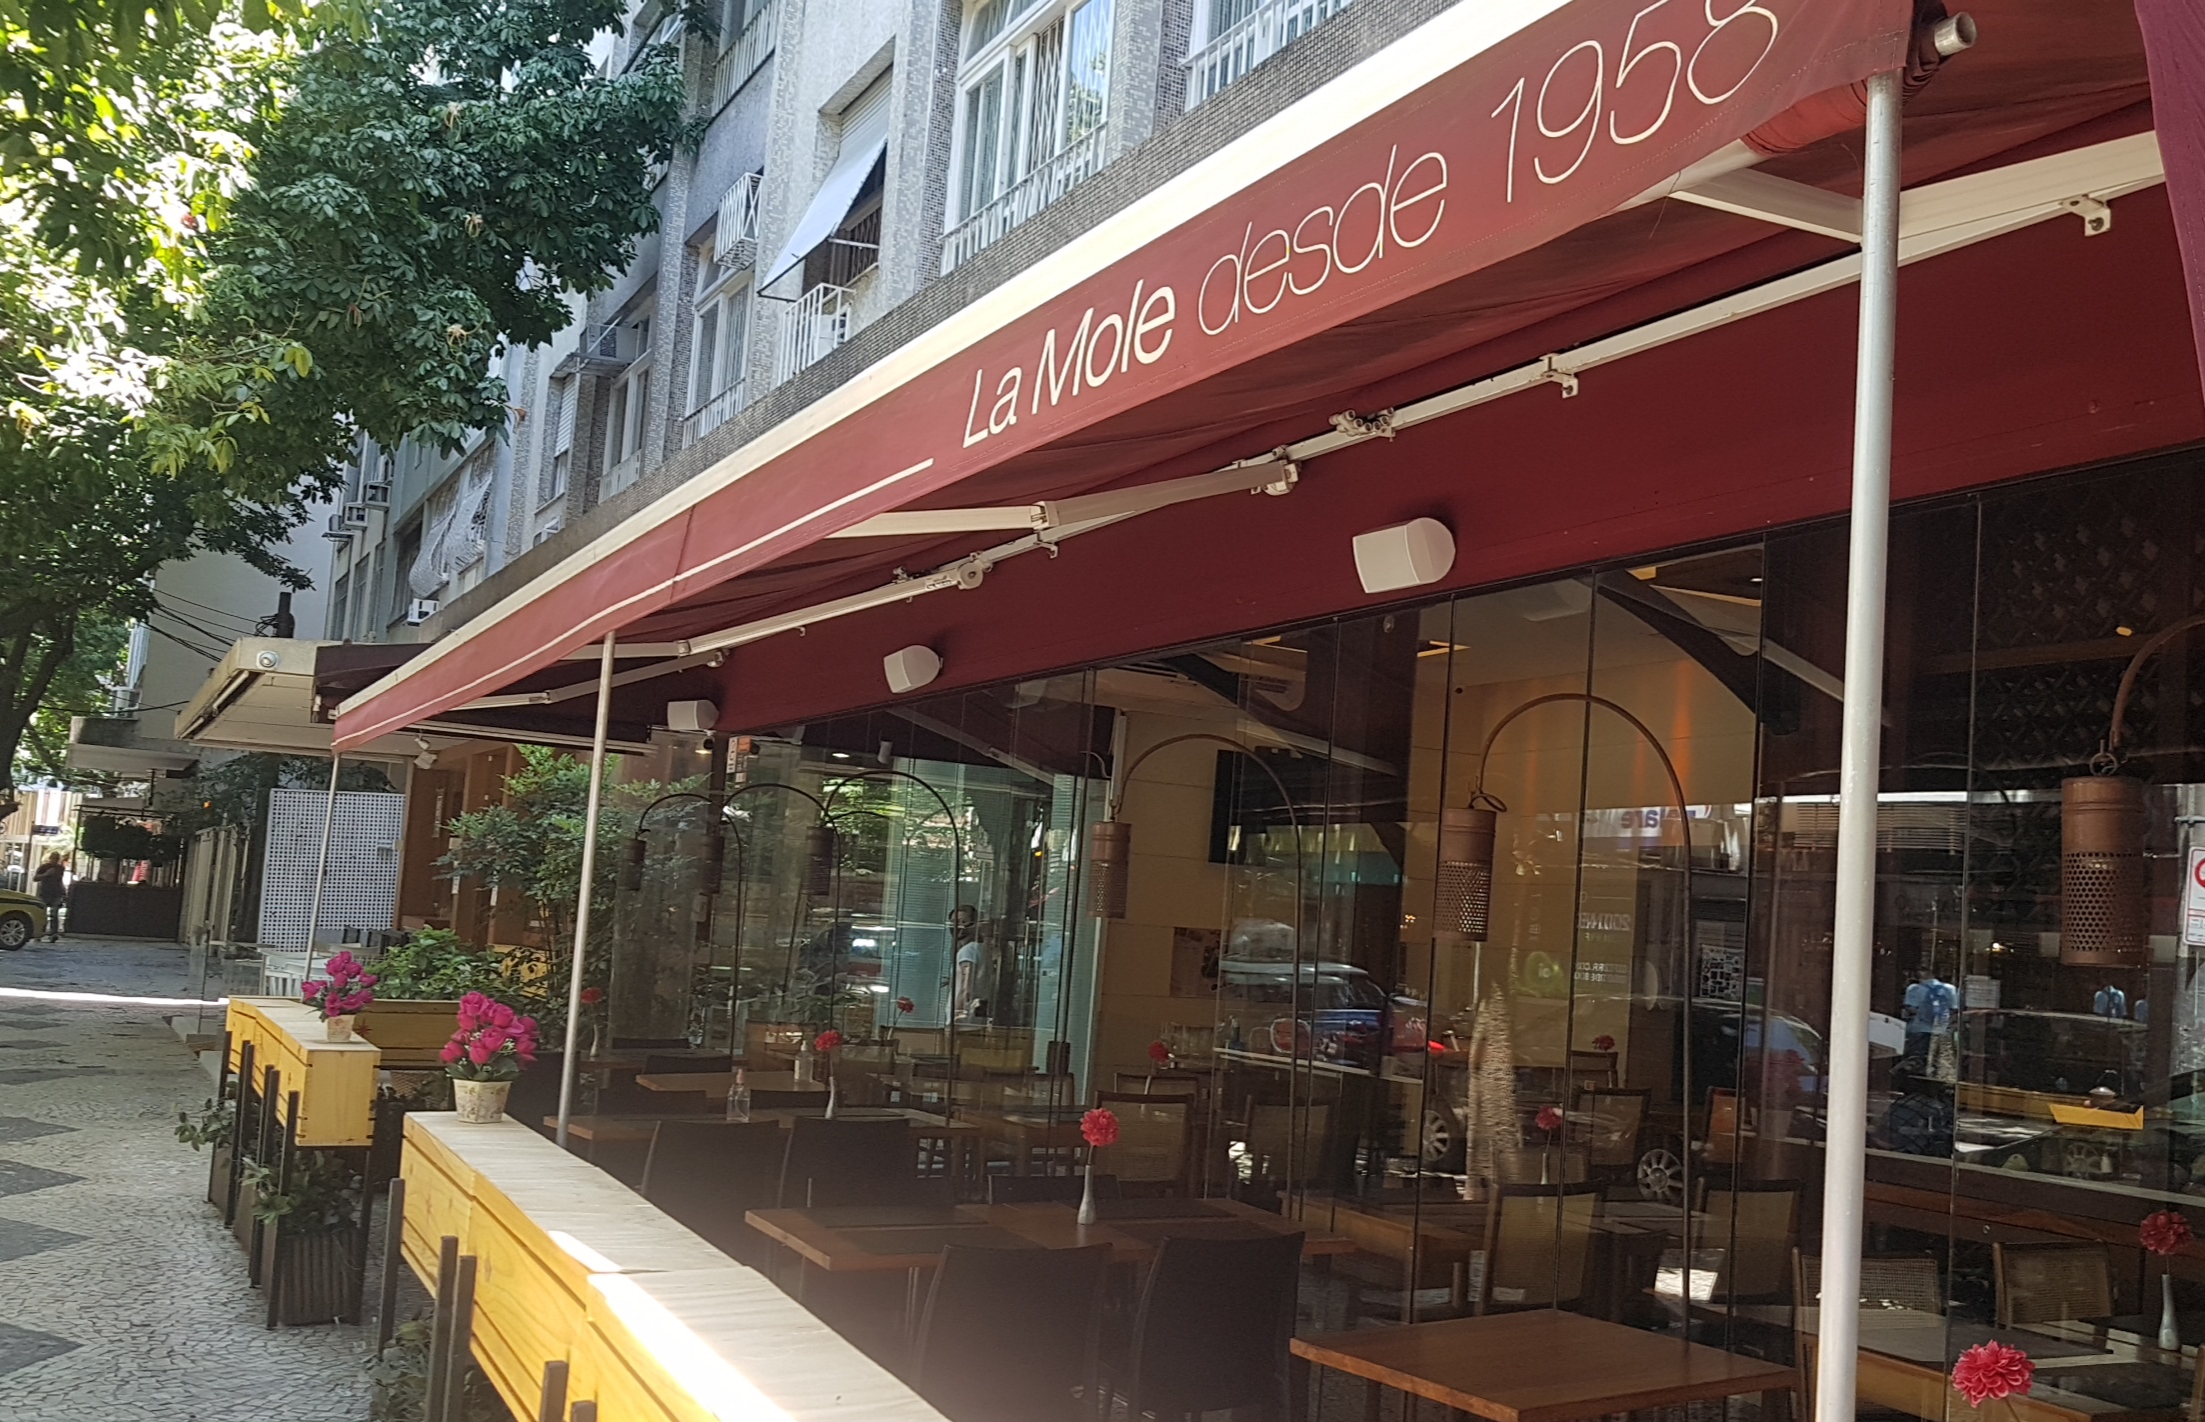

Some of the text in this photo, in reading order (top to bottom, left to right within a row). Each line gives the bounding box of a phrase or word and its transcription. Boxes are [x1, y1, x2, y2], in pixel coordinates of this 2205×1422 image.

[963, 0, 1778, 448] La Mole desde 1958
